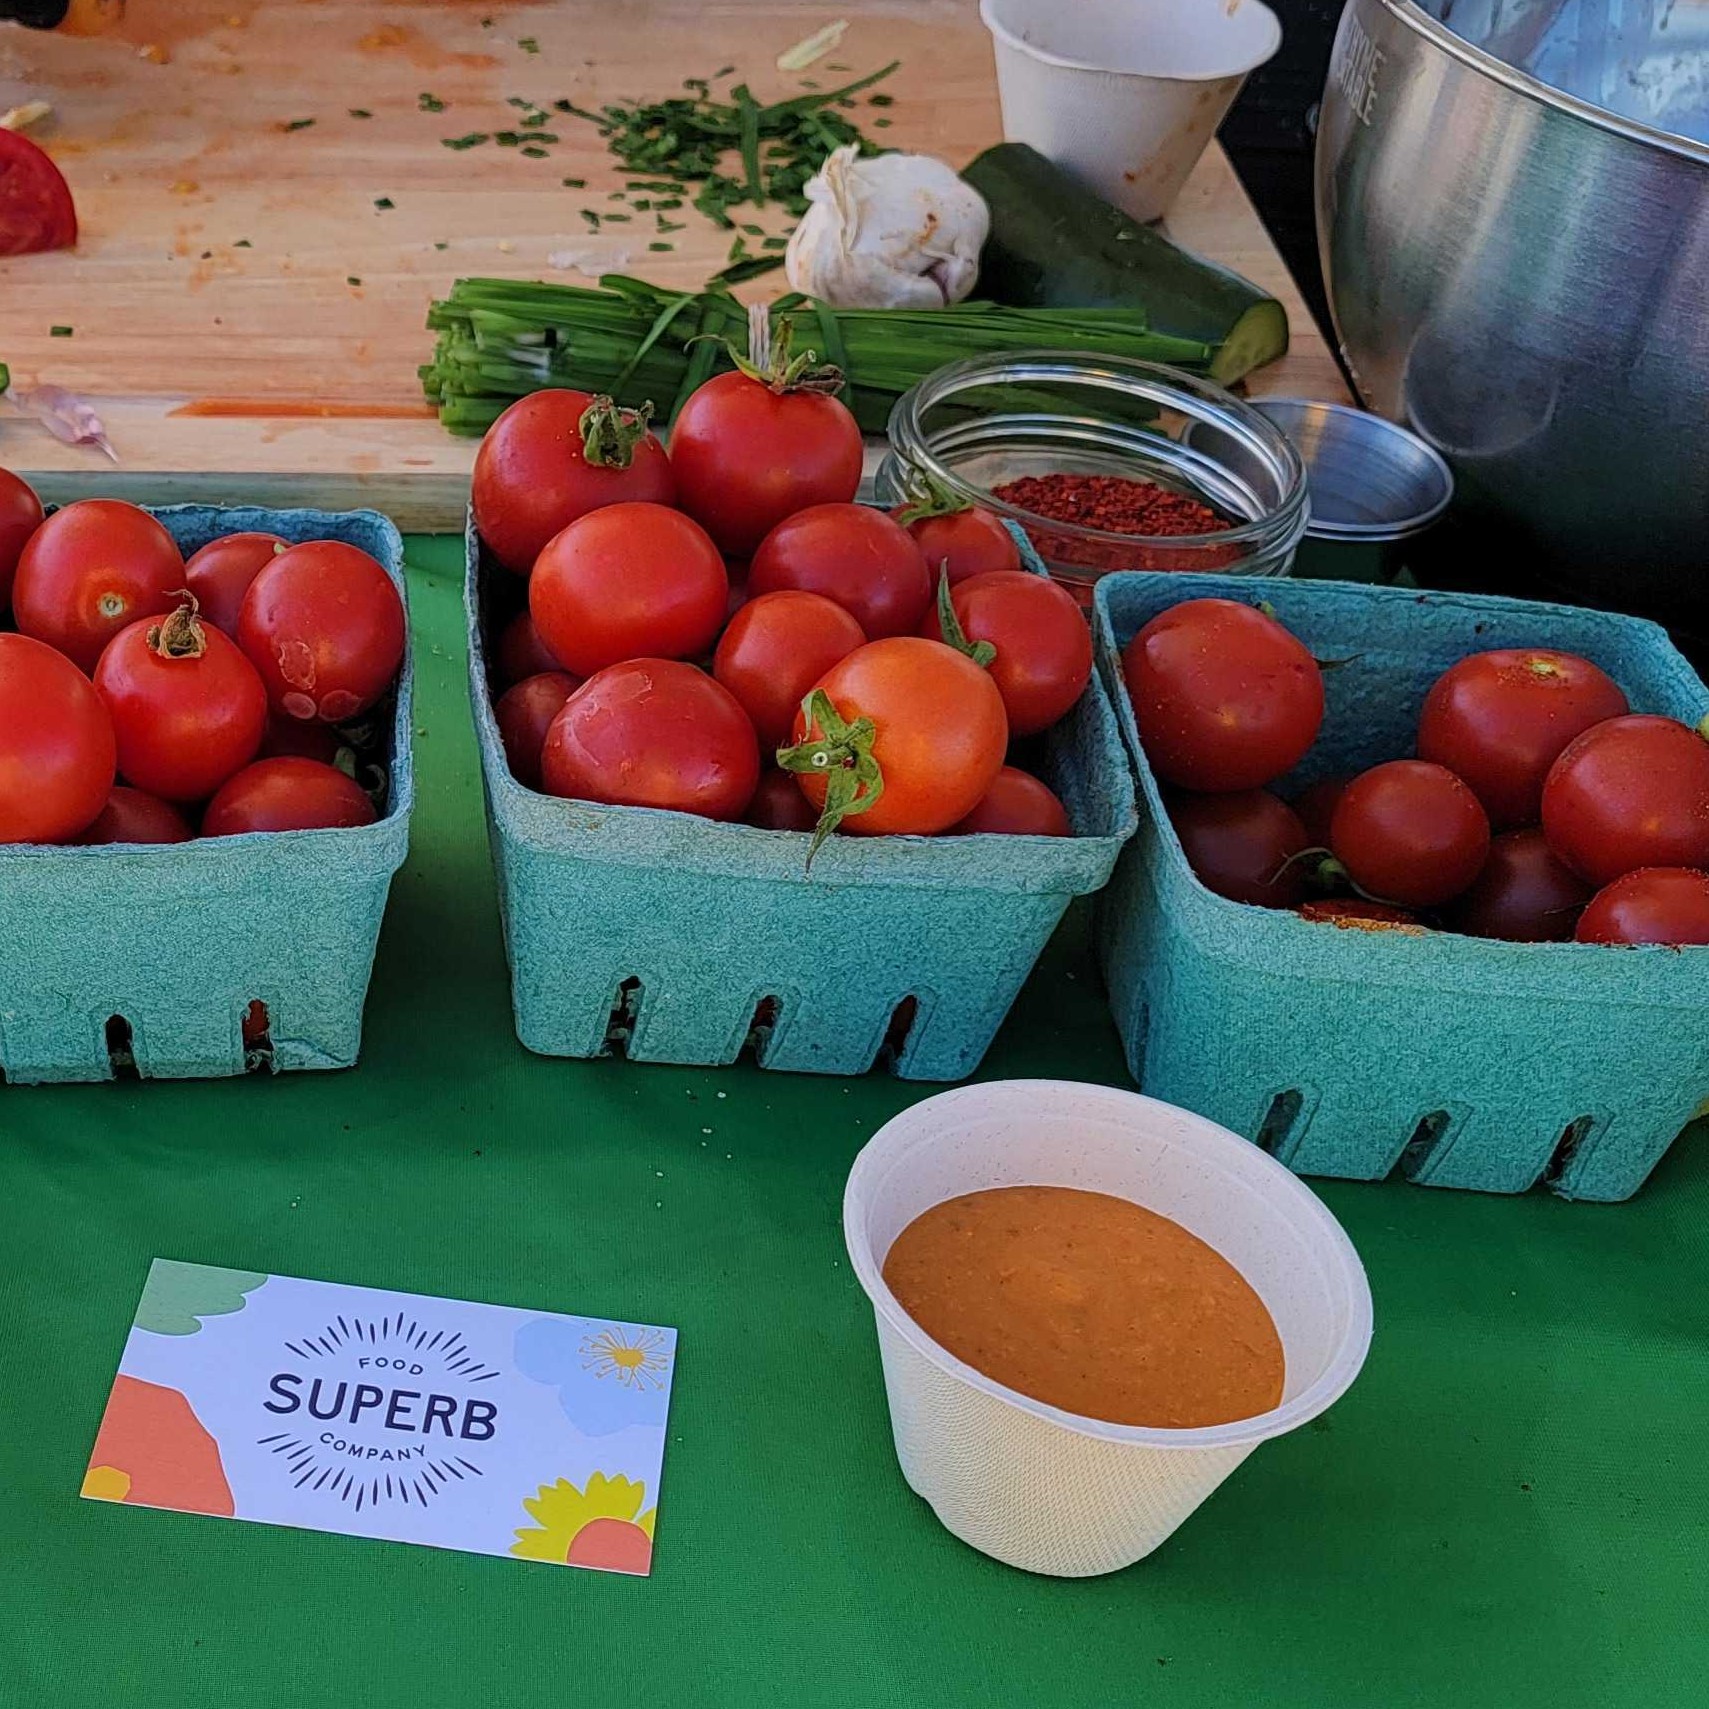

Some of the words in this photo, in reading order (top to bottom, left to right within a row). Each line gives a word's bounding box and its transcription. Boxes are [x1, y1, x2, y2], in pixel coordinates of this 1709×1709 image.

[358, 1356, 424, 1376] FOOD
[262, 1373, 498, 1442] SUPERB
[319, 1432, 426, 1462] COMPANY
